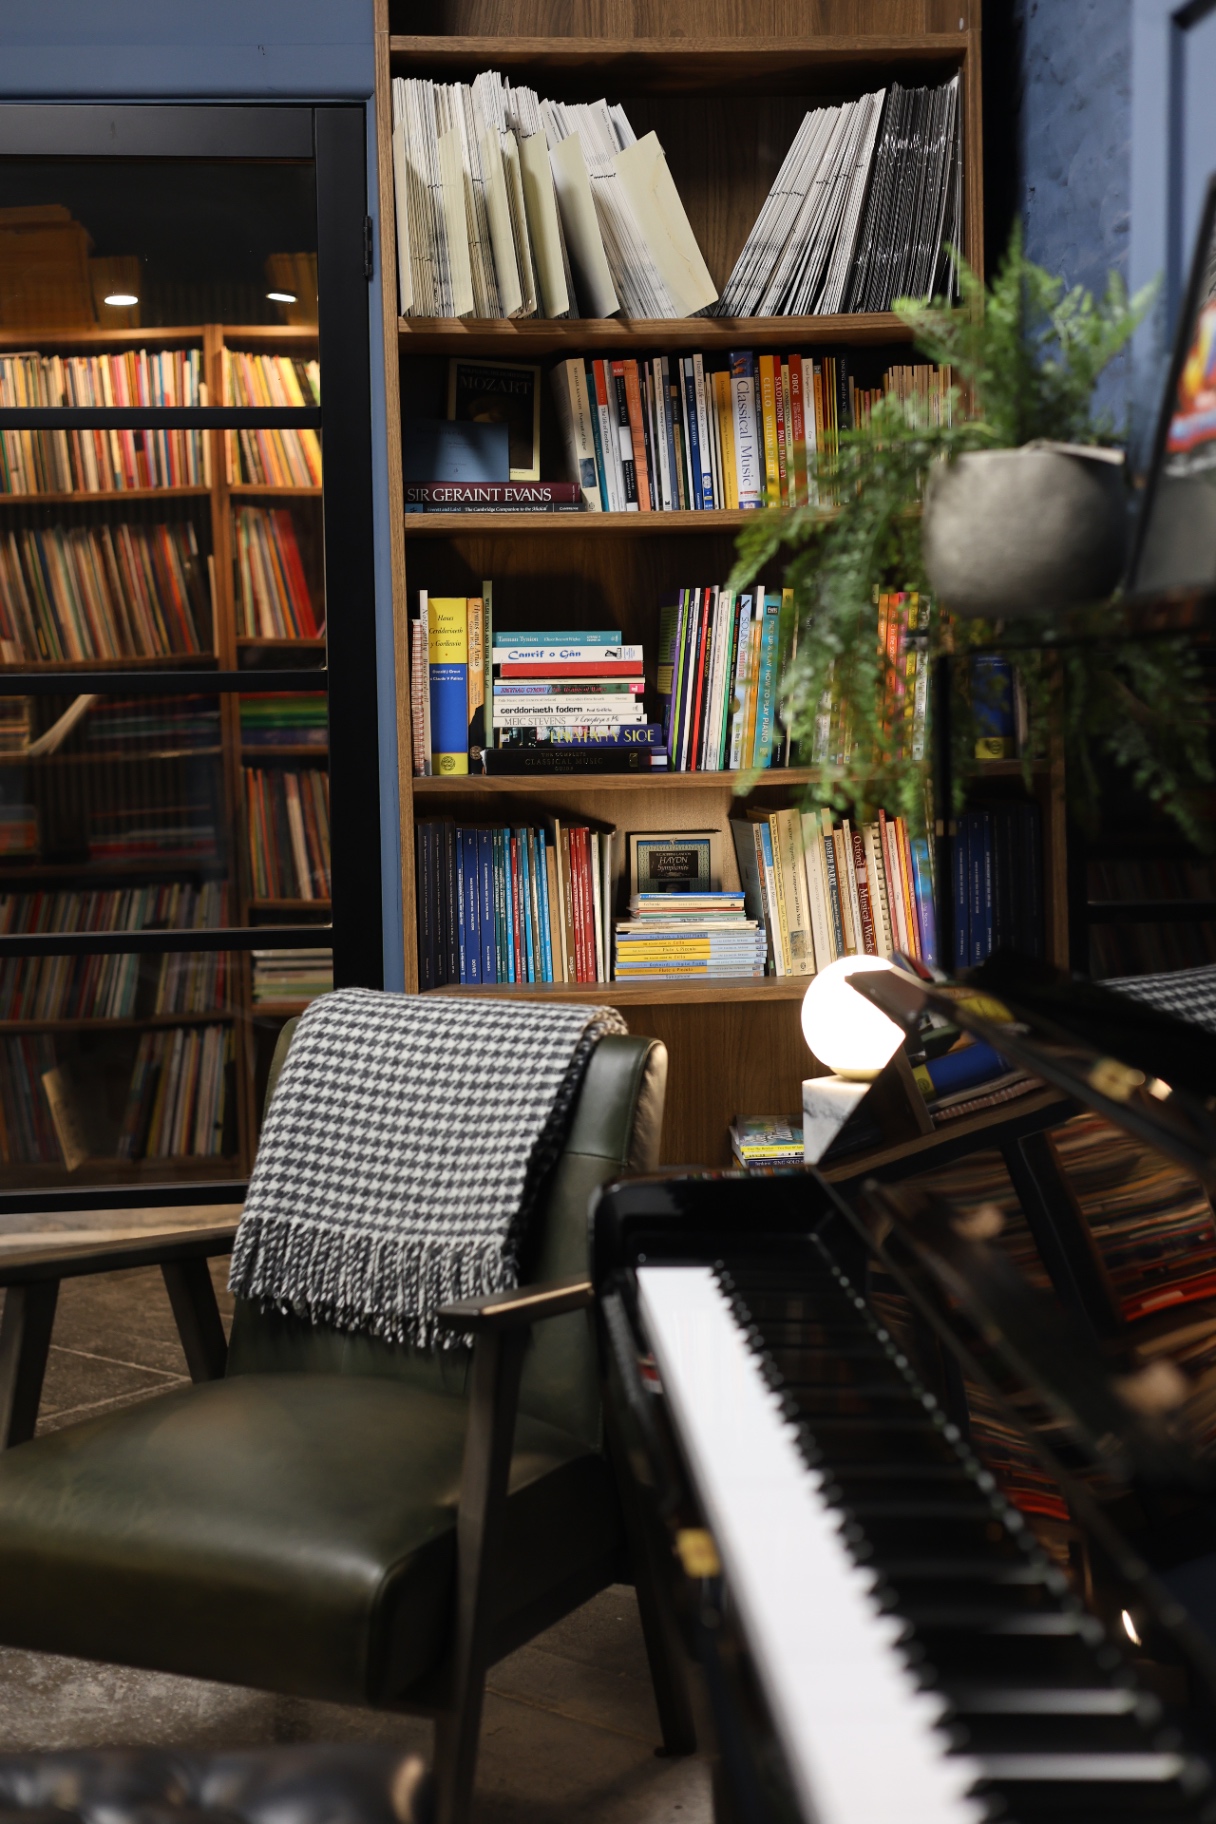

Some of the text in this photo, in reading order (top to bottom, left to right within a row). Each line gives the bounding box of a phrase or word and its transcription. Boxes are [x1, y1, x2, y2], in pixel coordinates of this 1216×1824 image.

[460, 375, 532, 394] MOZART
[763, 377, 771, 407] CELLO
[791, 373, 799, 395] OBOE
[775, 376, 784, 423] SAXOPHONE
[736, 380, 755, 486] Classical Music
[765, 415, 774, 448] WILLIAM
[407, 488, 552, 502] SIR GERAINT EVANS
[472, 604, 481, 630] Hymns
[739, 616, 749, 649] SOUND
[767, 635, 774, 644] UP
[508, 650, 544, 660] Canrif
[560, 649, 581, 659] Gân
[764, 688, 771, 698] TO
[504, 717, 566, 726] MEIC STEVENS
[761, 717, 769, 743] PIANO
[623, 729, 655, 742] SIOE
[659, 855, 688, 865] HAYDN
[853, 835, 865, 867] Oxford
[656, 862, 689, 872] Symphonies
[826, 840, 836, 887] JOSEPH PARRY
[860, 888, 875, 953] Musical Works
